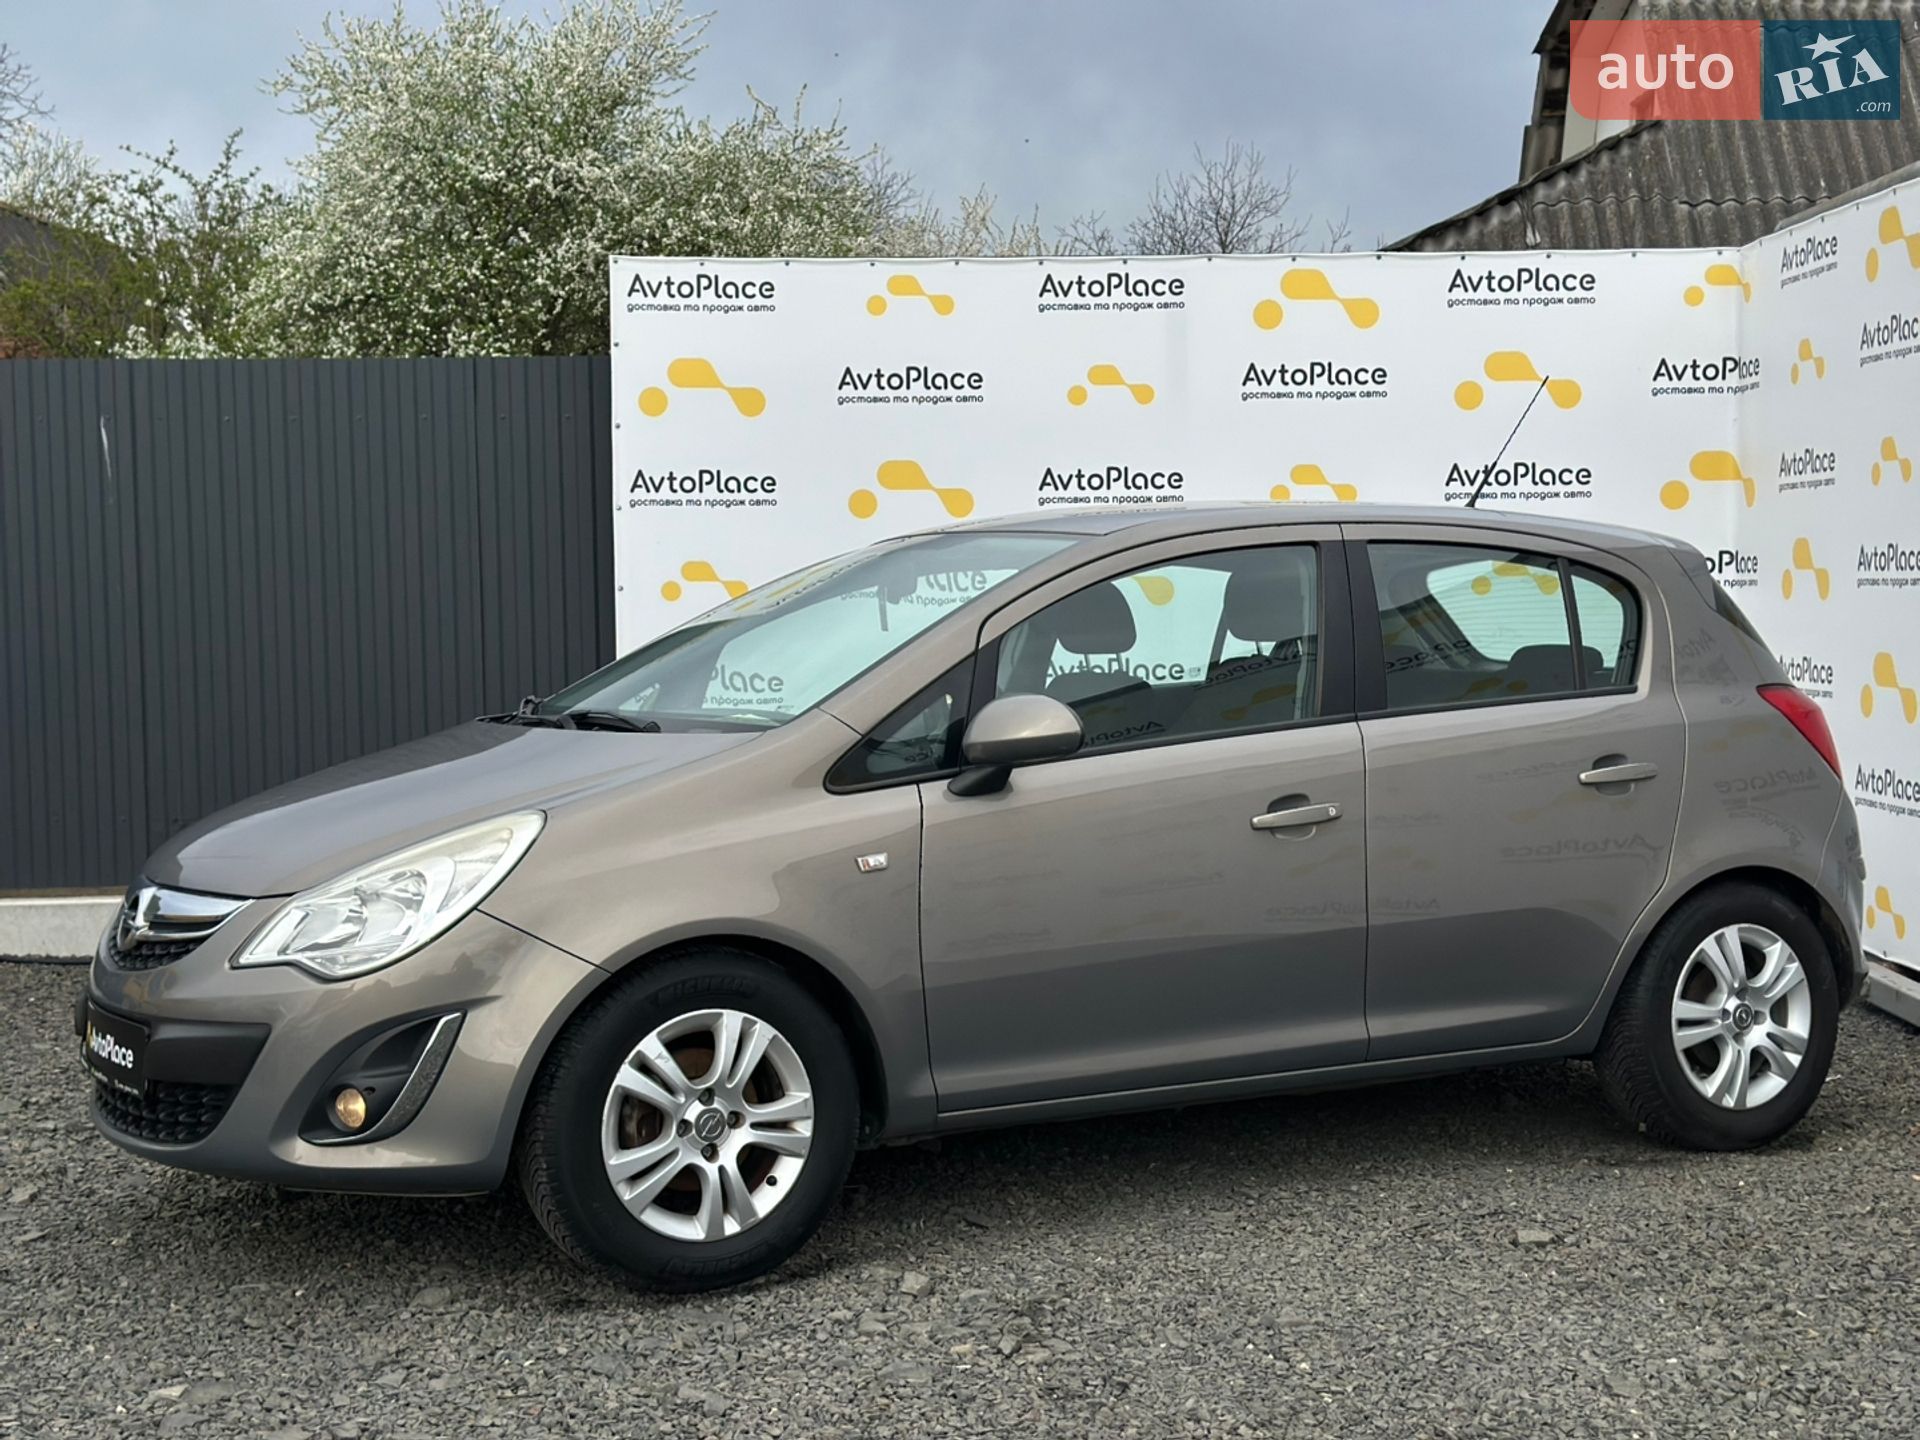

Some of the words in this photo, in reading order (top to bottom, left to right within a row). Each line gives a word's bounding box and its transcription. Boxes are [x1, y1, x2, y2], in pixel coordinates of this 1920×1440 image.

[1781, 235, 1838, 273] AvtoPlace
[627, 274, 775, 299] AvtoPlace
[1039, 272, 1184, 298] AvtoPlace
[1448, 267, 1595, 293] AvtoPlace
[838, 366, 983, 390] AvtoPlace
[1242, 362, 1387, 386] AvtoPlace
[1653, 356, 1759, 381] AvtoPlace
[1445, 462, 1592, 487] AvtoPlace
[1779, 447, 1836, 477] AvtoPlace
[630, 469, 776, 493] AvtoPlace
[1039, 466, 1184, 491] AvtoPlace
[1445, 492, 1498, 502] доствка
[1854, 763, 1920, 802] AvtoPlace
